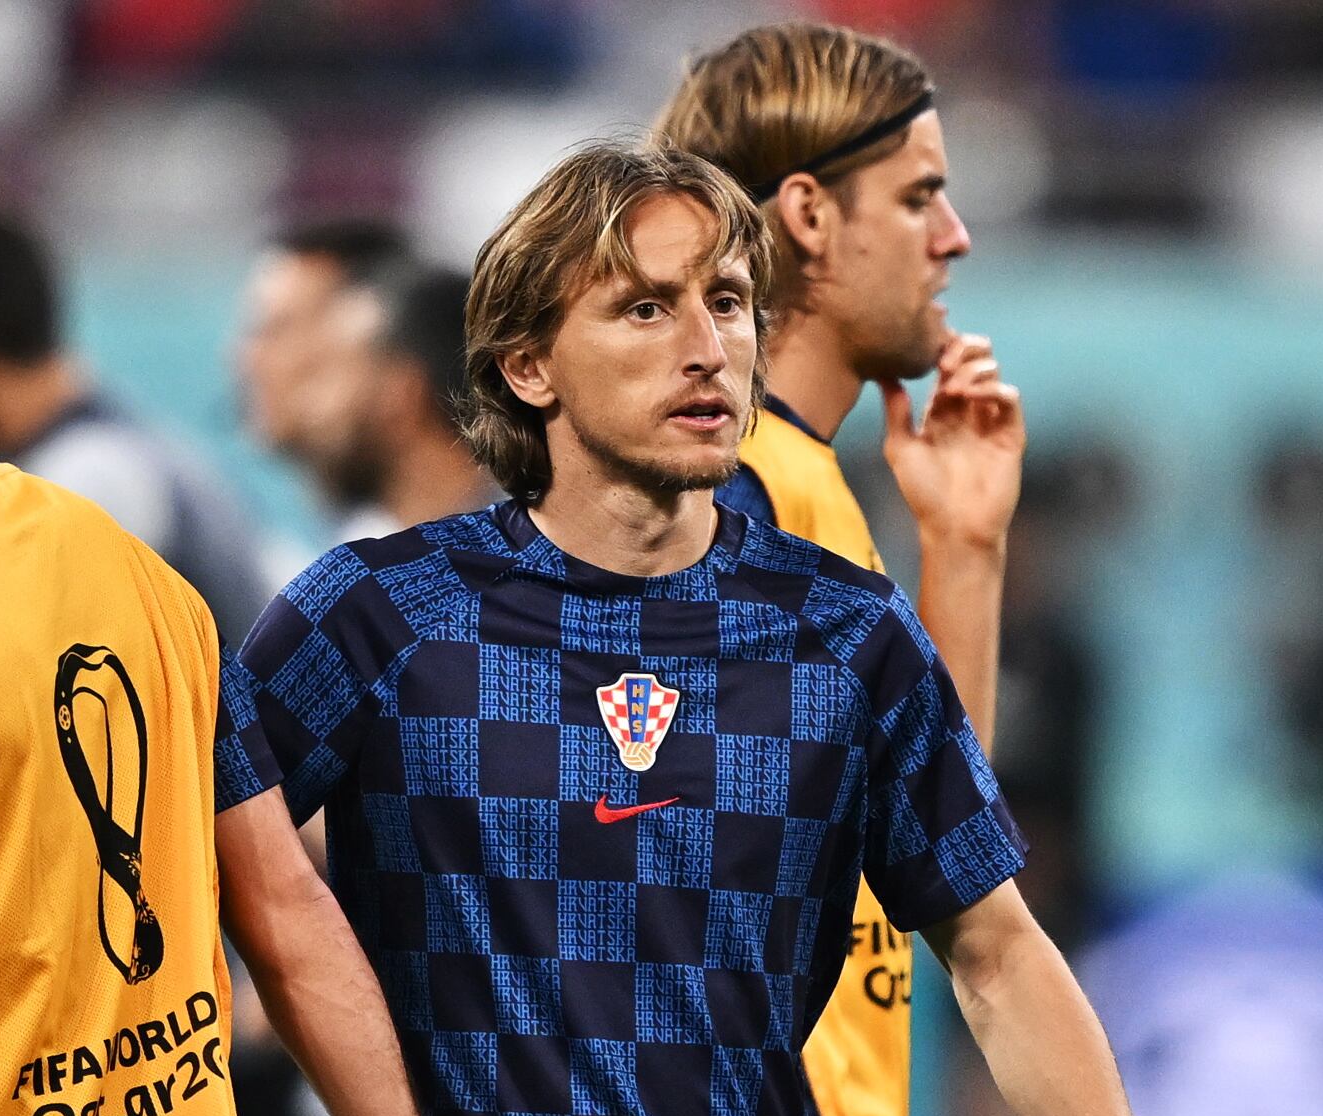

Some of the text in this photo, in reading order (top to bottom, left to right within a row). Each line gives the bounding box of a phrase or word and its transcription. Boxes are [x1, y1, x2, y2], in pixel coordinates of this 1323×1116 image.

[644, 583, 718, 601] HRVATSKA
[562, 608, 641, 626] HRVATSKA
[719, 615, 797, 631] HRVATSKA
[561, 622, 641, 641] HRVATSKA
[720, 630, 796, 647] HRVATSKA
[479, 644, 561, 663] HRVATSKA
[561, 636, 641, 656] HRVATSKA
[720, 645, 793, 663] HRVATSKA
[479, 660, 561, 678] HRVATSKA
[640, 655, 717, 673] HRVATSKA
[479, 675, 561, 694] HRVATSKA
[659, 672, 717, 688] VATSKA
[479, 690, 560, 709] HRVATSKA
[265, 676, 332, 742] HRVATSKA
[479, 706, 560, 724] HRVATSKA
[632, 684, 645, 734] HNS
[400, 717, 479, 734] HRVATSKA
[401, 733, 479, 750] HRVATSKA
[559, 740, 615, 757] HRVAT
[716, 734, 790, 753] HRVATSKA
[403, 749, 479, 766] HRVATSKA
[559, 755, 623, 773] HRVATS
[716, 750, 789, 769] HRVATSKA
[405, 765, 479, 782] HRVATSKA
[559, 770, 639, 789] HRVATSKA
[715, 765, 789, 784] HRVATSKA
[406, 781, 479, 798] HRVATSKA
[715, 780, 788, 800] HRVATSKA
[479, 797, 559, 815] HRVATSKA
[715, 796, 787, 816] HRVATSKA
[481, 813, 559, 831] HRVATSKA
[638, 822, 714, 840] HRVATSKA
[934, 806, 994, 854] HRVATSKA
[482, 830, 559, 848] HRVATSKA
[637, 838, 713, 856] HRVATSKA
[939, 820, 1003, 870] HRVATSKA
[483, 846, 558, 864] HRVATSKA
[637, 853, 711, 873] HRVATSKA
[485, 862, 558, 880] HRVATSKA
[637, 869, 710, 889] HRVATSKA
[558, 880, 636, 897] HRVATSKA
[558, 896, 636, 913] HRVATSKA
[709, 889, 774, 909] HRVATSKA
[559, 912, 636, 930] HRVATSKA
[708, 905, 771, 925] HRVATSKA
[559, 929, 636, 946] HRVATSKA
[707, 922, 769, 941] HRVATSKA
[559, 945, 636, 962] HRVATSKA
[705, 938, 767, 957] HRVATSKA
[636, 963, 704, 982] HRVATSKA
[704, 954, 764, 973] HRVATSKA
[636, 979, 706, 998] HRVATSKA
[636, 996, 708, 1014] HRVATSKA
[636, 1012, 710, 1029] HRVATSKA
[636, 1028, 712, 1045] HRVATSKA
[12, 1045, 103, 1100] FIFA
